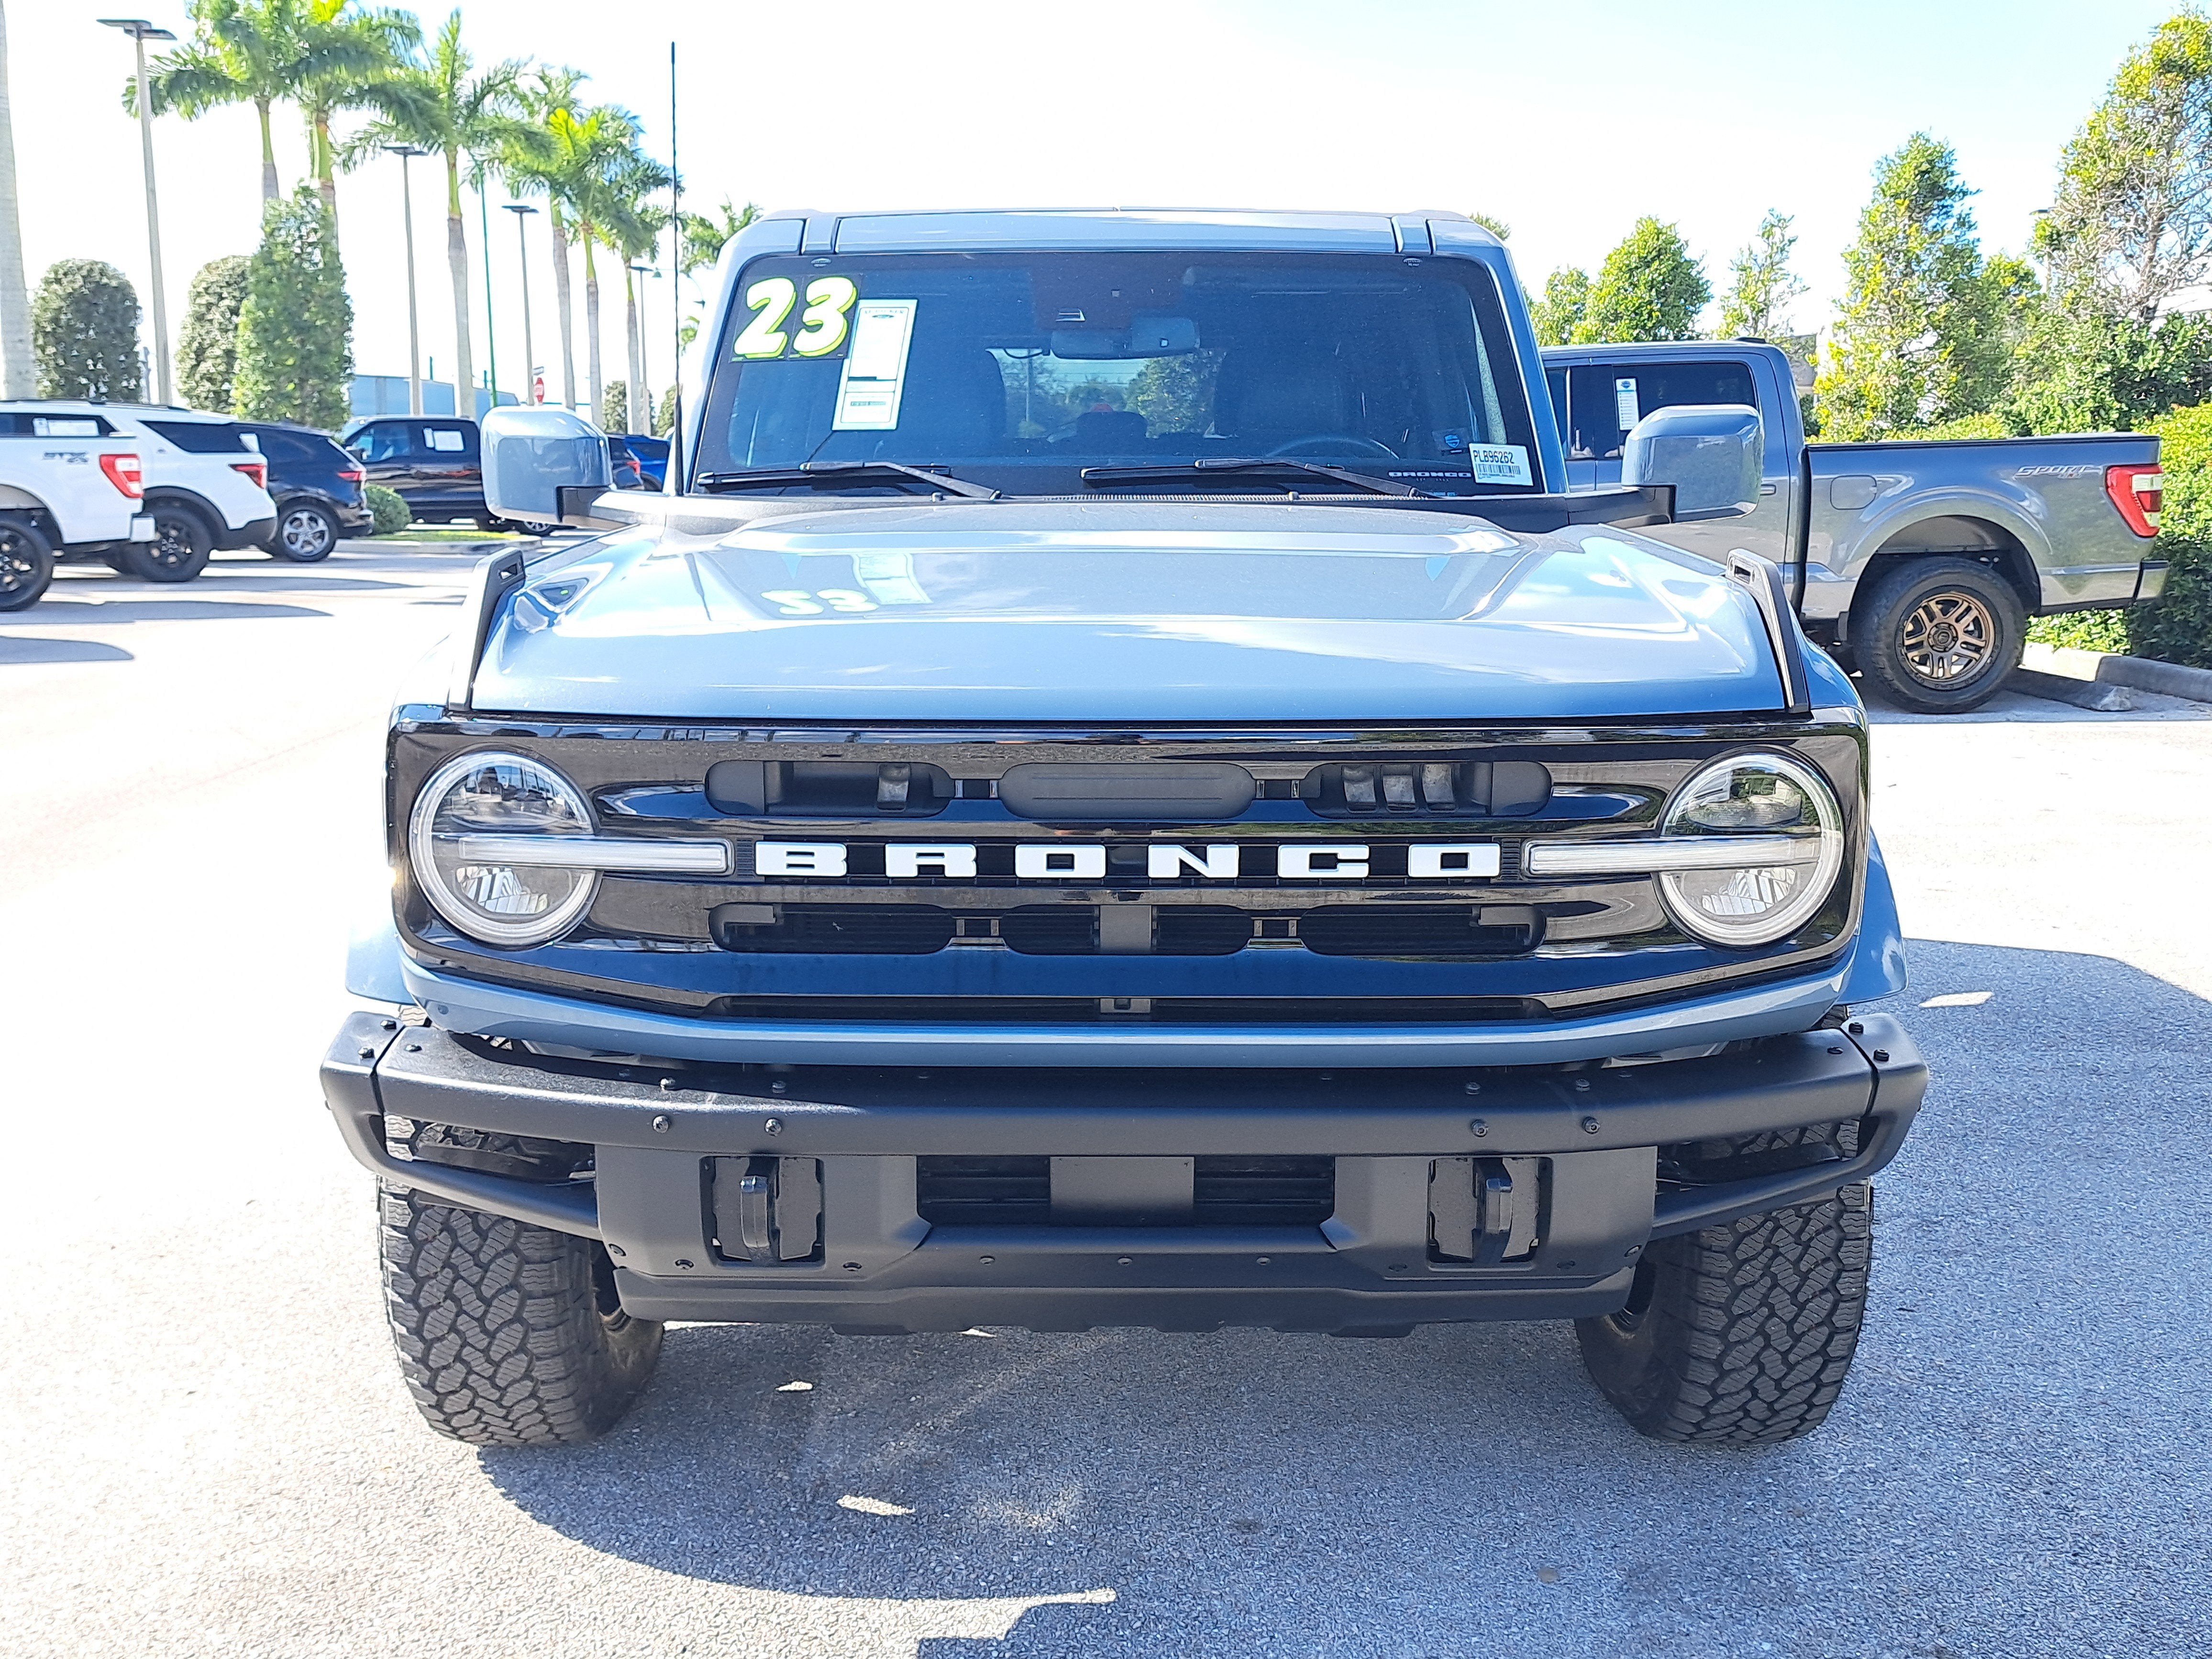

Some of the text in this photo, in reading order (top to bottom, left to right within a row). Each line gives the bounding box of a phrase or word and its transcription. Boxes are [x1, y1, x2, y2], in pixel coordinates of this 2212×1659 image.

[733, 276, 858, 359] 23
[1473, 450, 1515, 464] PLB96262
[755, 841, 1501, 878] BRONCO
